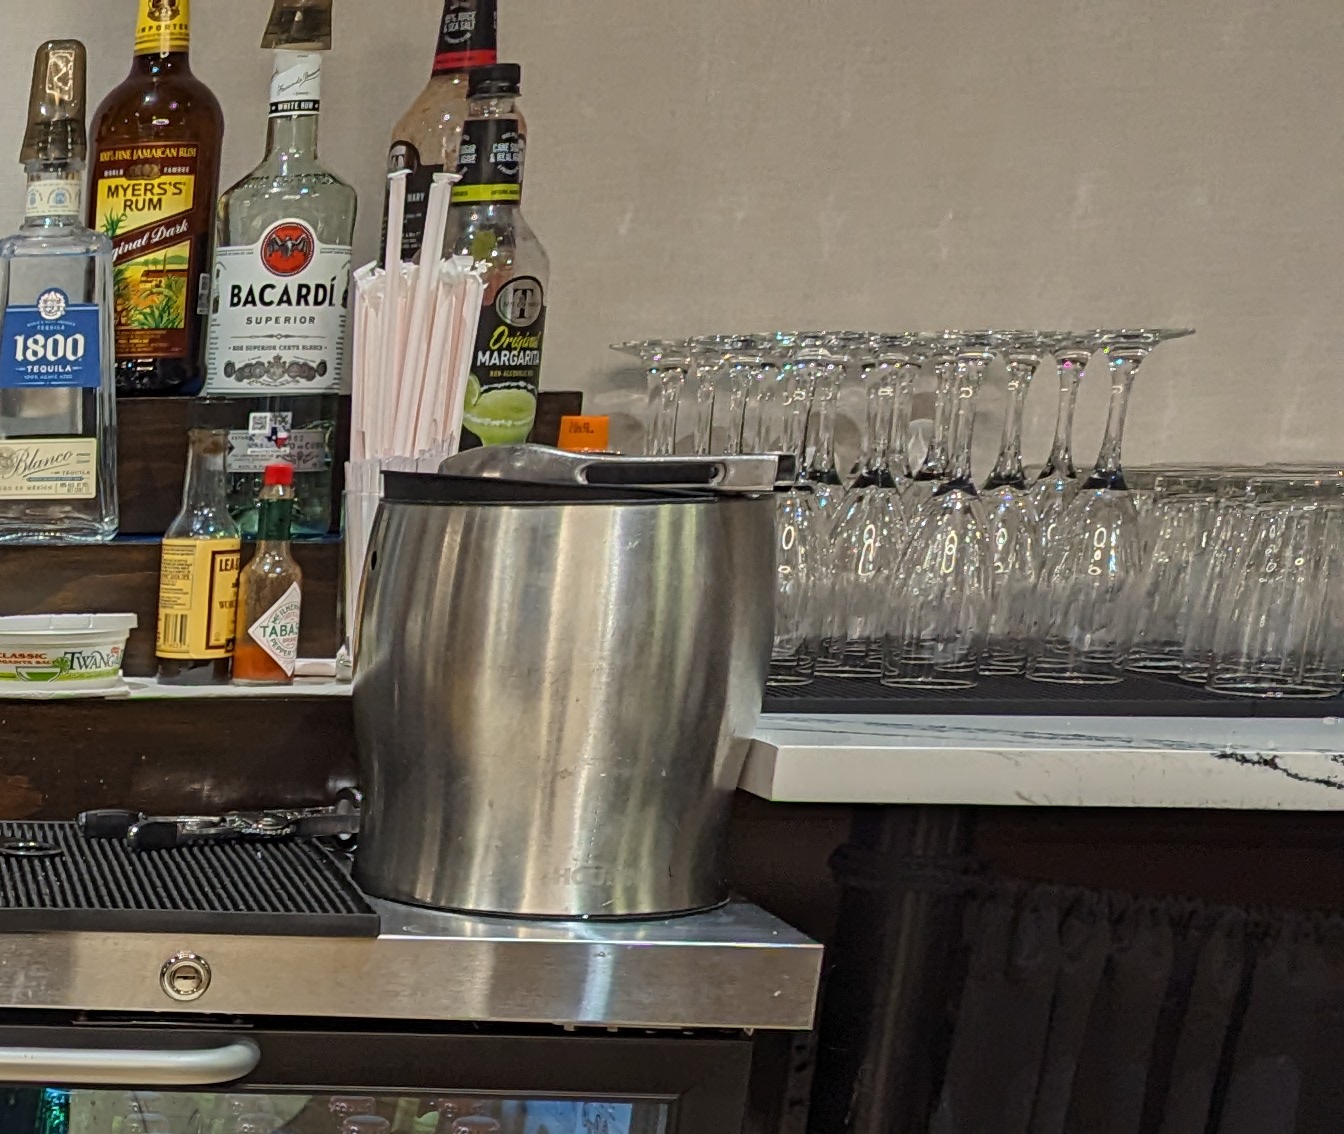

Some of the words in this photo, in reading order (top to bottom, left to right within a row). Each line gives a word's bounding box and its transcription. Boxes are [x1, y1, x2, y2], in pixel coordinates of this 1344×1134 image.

[123, 198, 162, 212] RUM
[150, 219, 189, 244] Dark
[229, 276, 337, 308] BACARDÍ
[245, 316, 316, 325] SUPERIOR
[14, 333, 86, 362] 1800
[26, 365, 72, 373] TEQUILA
[4, 447, 74, 480] Blanco
